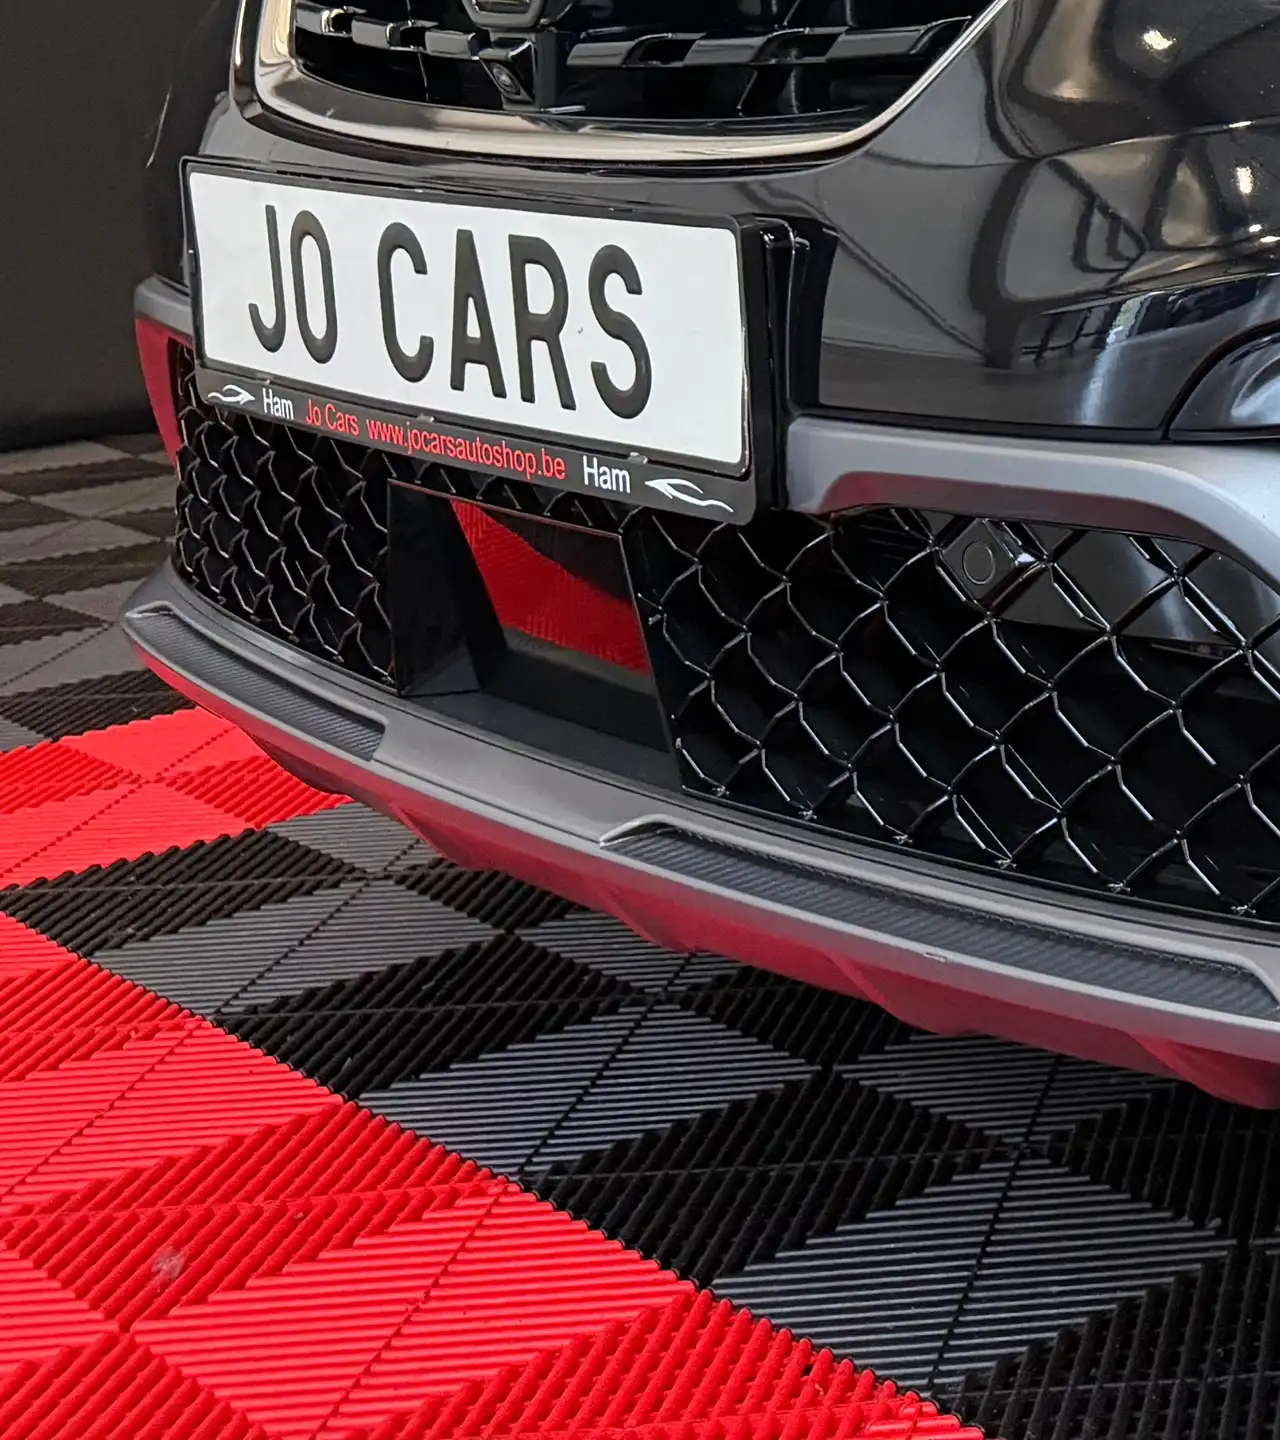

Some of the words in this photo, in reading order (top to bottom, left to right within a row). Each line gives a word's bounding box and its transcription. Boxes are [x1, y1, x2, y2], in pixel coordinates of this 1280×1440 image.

[247, 203, 339, 364] JO
[376, 221, 653, 420] CARS
[262, 388, 295, 421] Ham
[305, 399, 322, 427] Jo
[325, 405, 360, 436] Cars
[366, 419, 566, 481] www.jocarsautoshop.be
[582, 455, 632, 494] Ham
